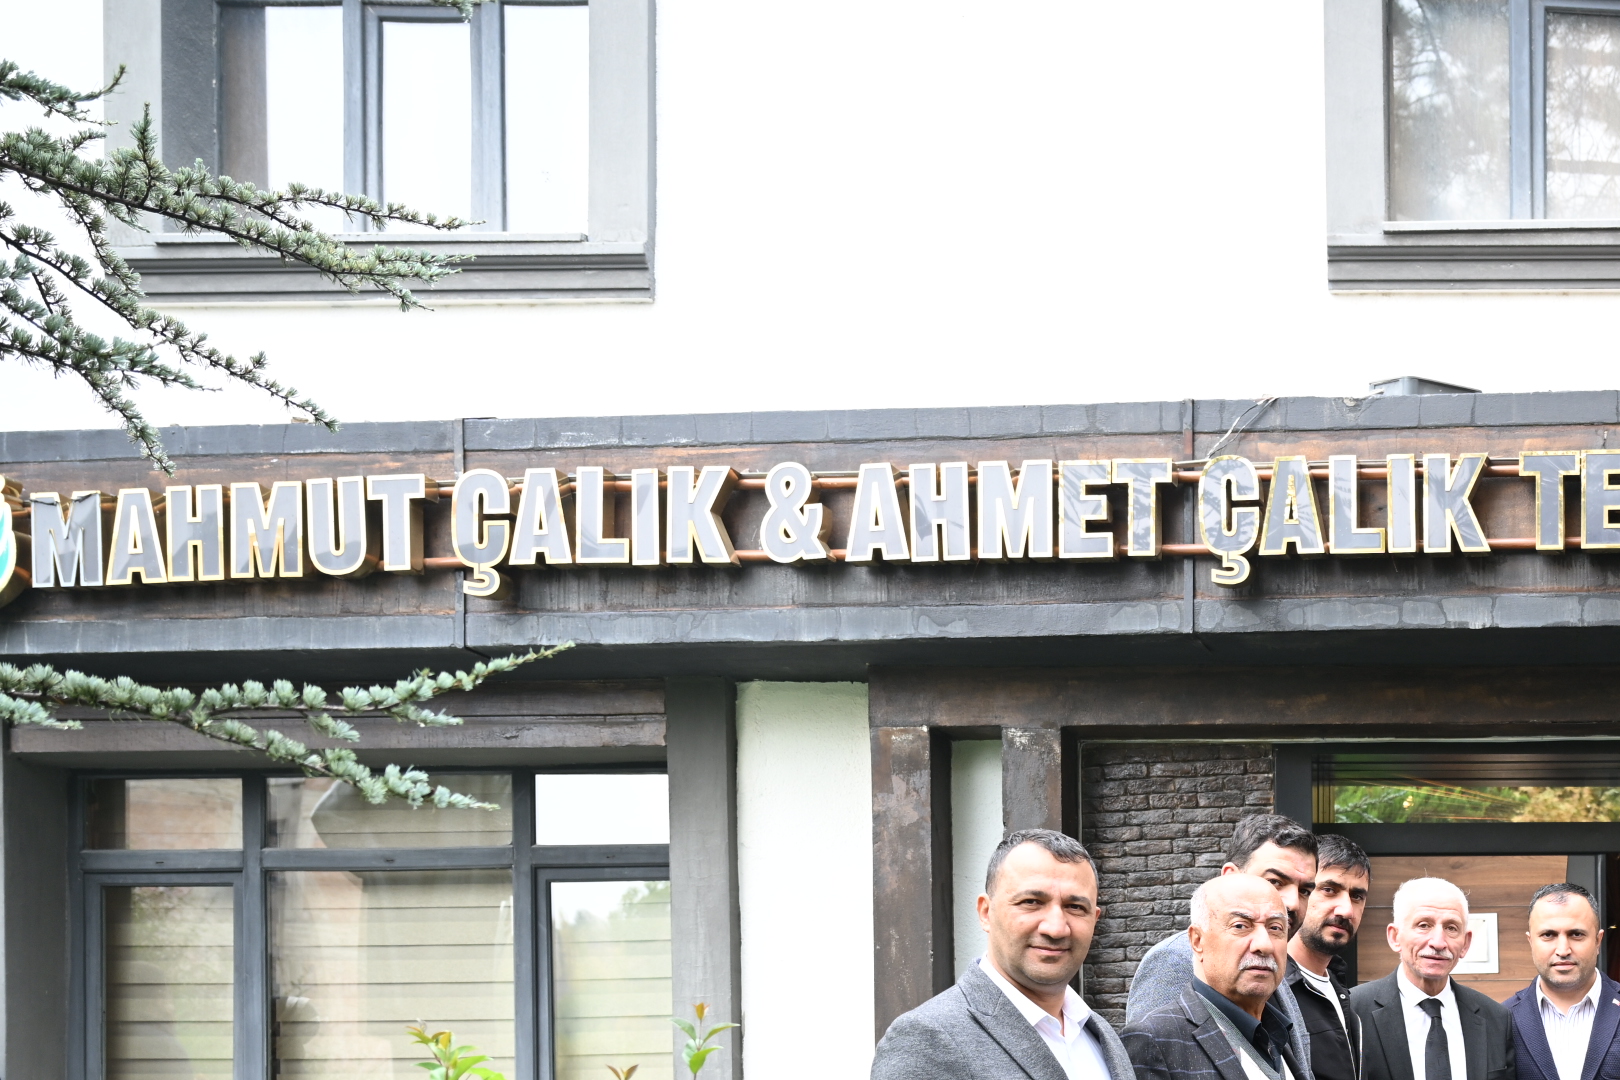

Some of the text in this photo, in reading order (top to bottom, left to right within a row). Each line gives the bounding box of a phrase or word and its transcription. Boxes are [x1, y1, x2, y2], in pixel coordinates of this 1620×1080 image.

[30, 474, 426, 588] MAHMUT
[451, 465, 732, 597] ÇALIK
[760, 461, 827, 564] &
[845, 458, 1172, 563] AHMET
[1200, 452, 1490, 586] ÇALIK
